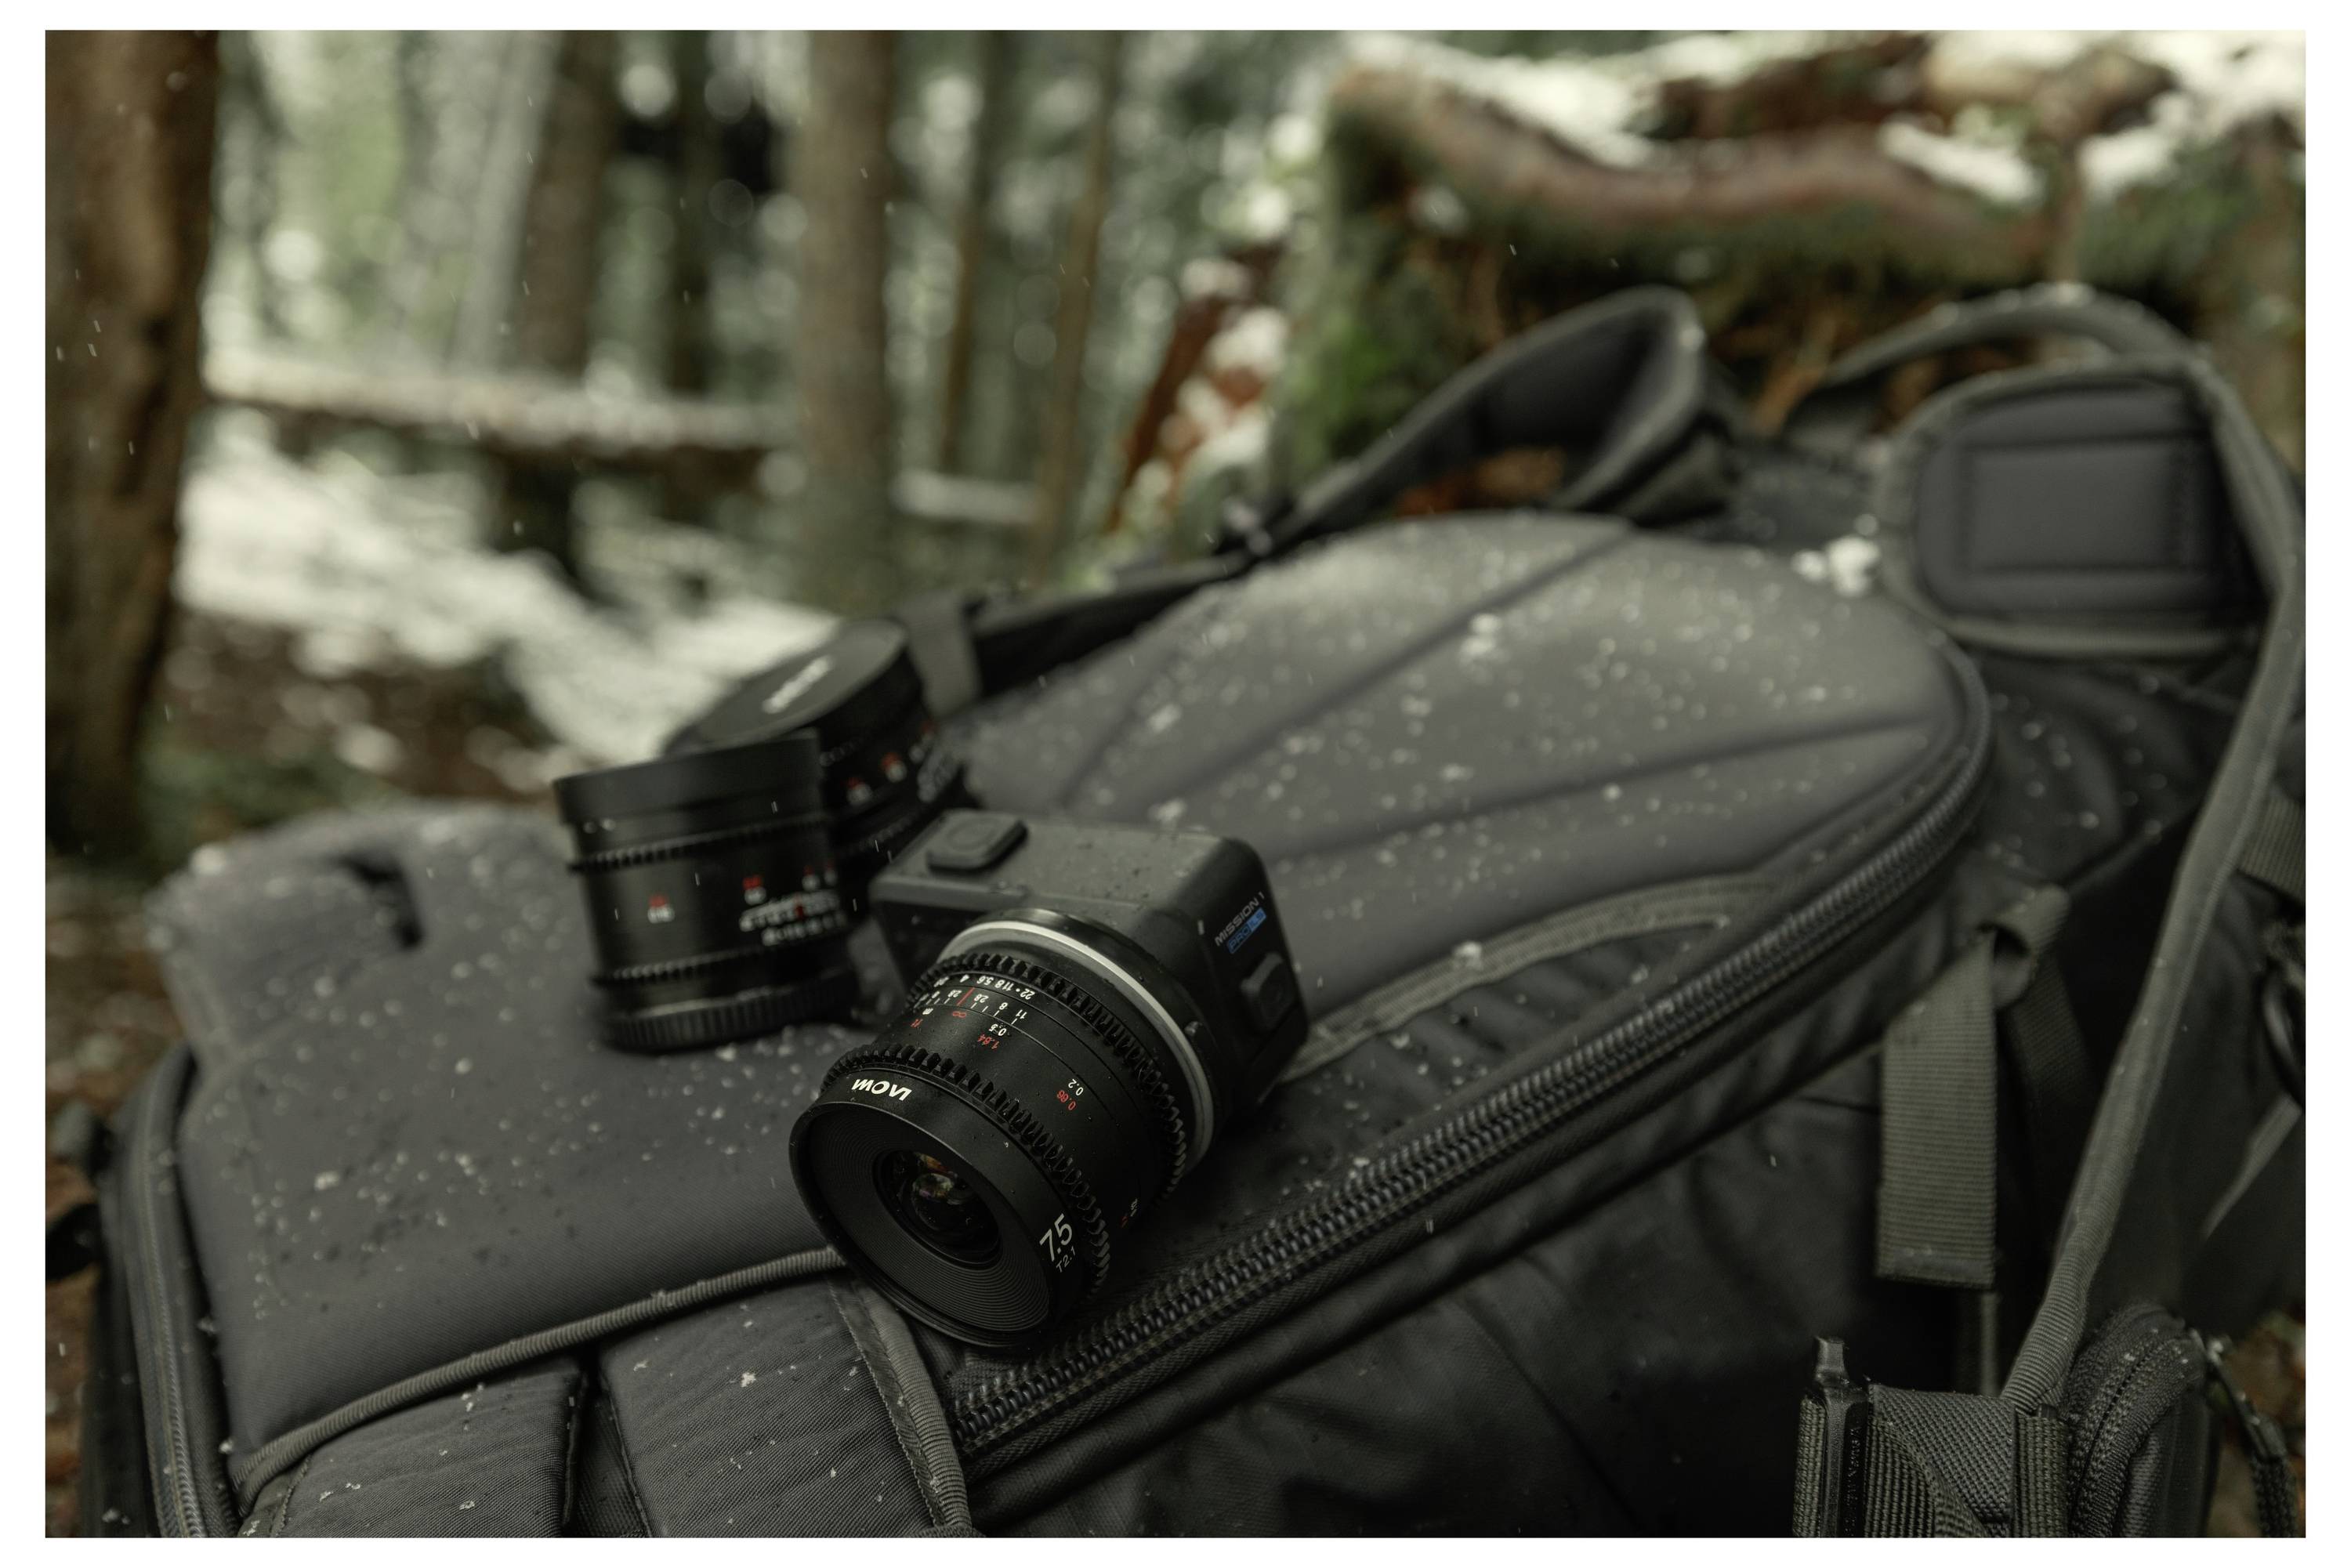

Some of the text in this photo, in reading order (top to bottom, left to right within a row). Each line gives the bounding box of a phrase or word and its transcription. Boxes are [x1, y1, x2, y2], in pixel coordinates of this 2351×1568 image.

[1215, 891, 1265, 947] MISSION 1
[976, 976, 994, 986] 5.6
[994, 980, 1005, 989] 8
[1002, 981, 1014, 991] 11
[1020, 988, 1035, 1000] 22
[1015, 1009, 1027, 1019] 11
[988, 1023, 1007, 1036] 0.5
[977, 1034, 999, 1049] 1.64
[1068, 1078, 1084, 1095] 0.2
[1056, 1090, 1076, 1110] 0.66
[1039, 1213, 1073, 1262] 7.5
[1056, 1246, 1076, 1273] T2.1
